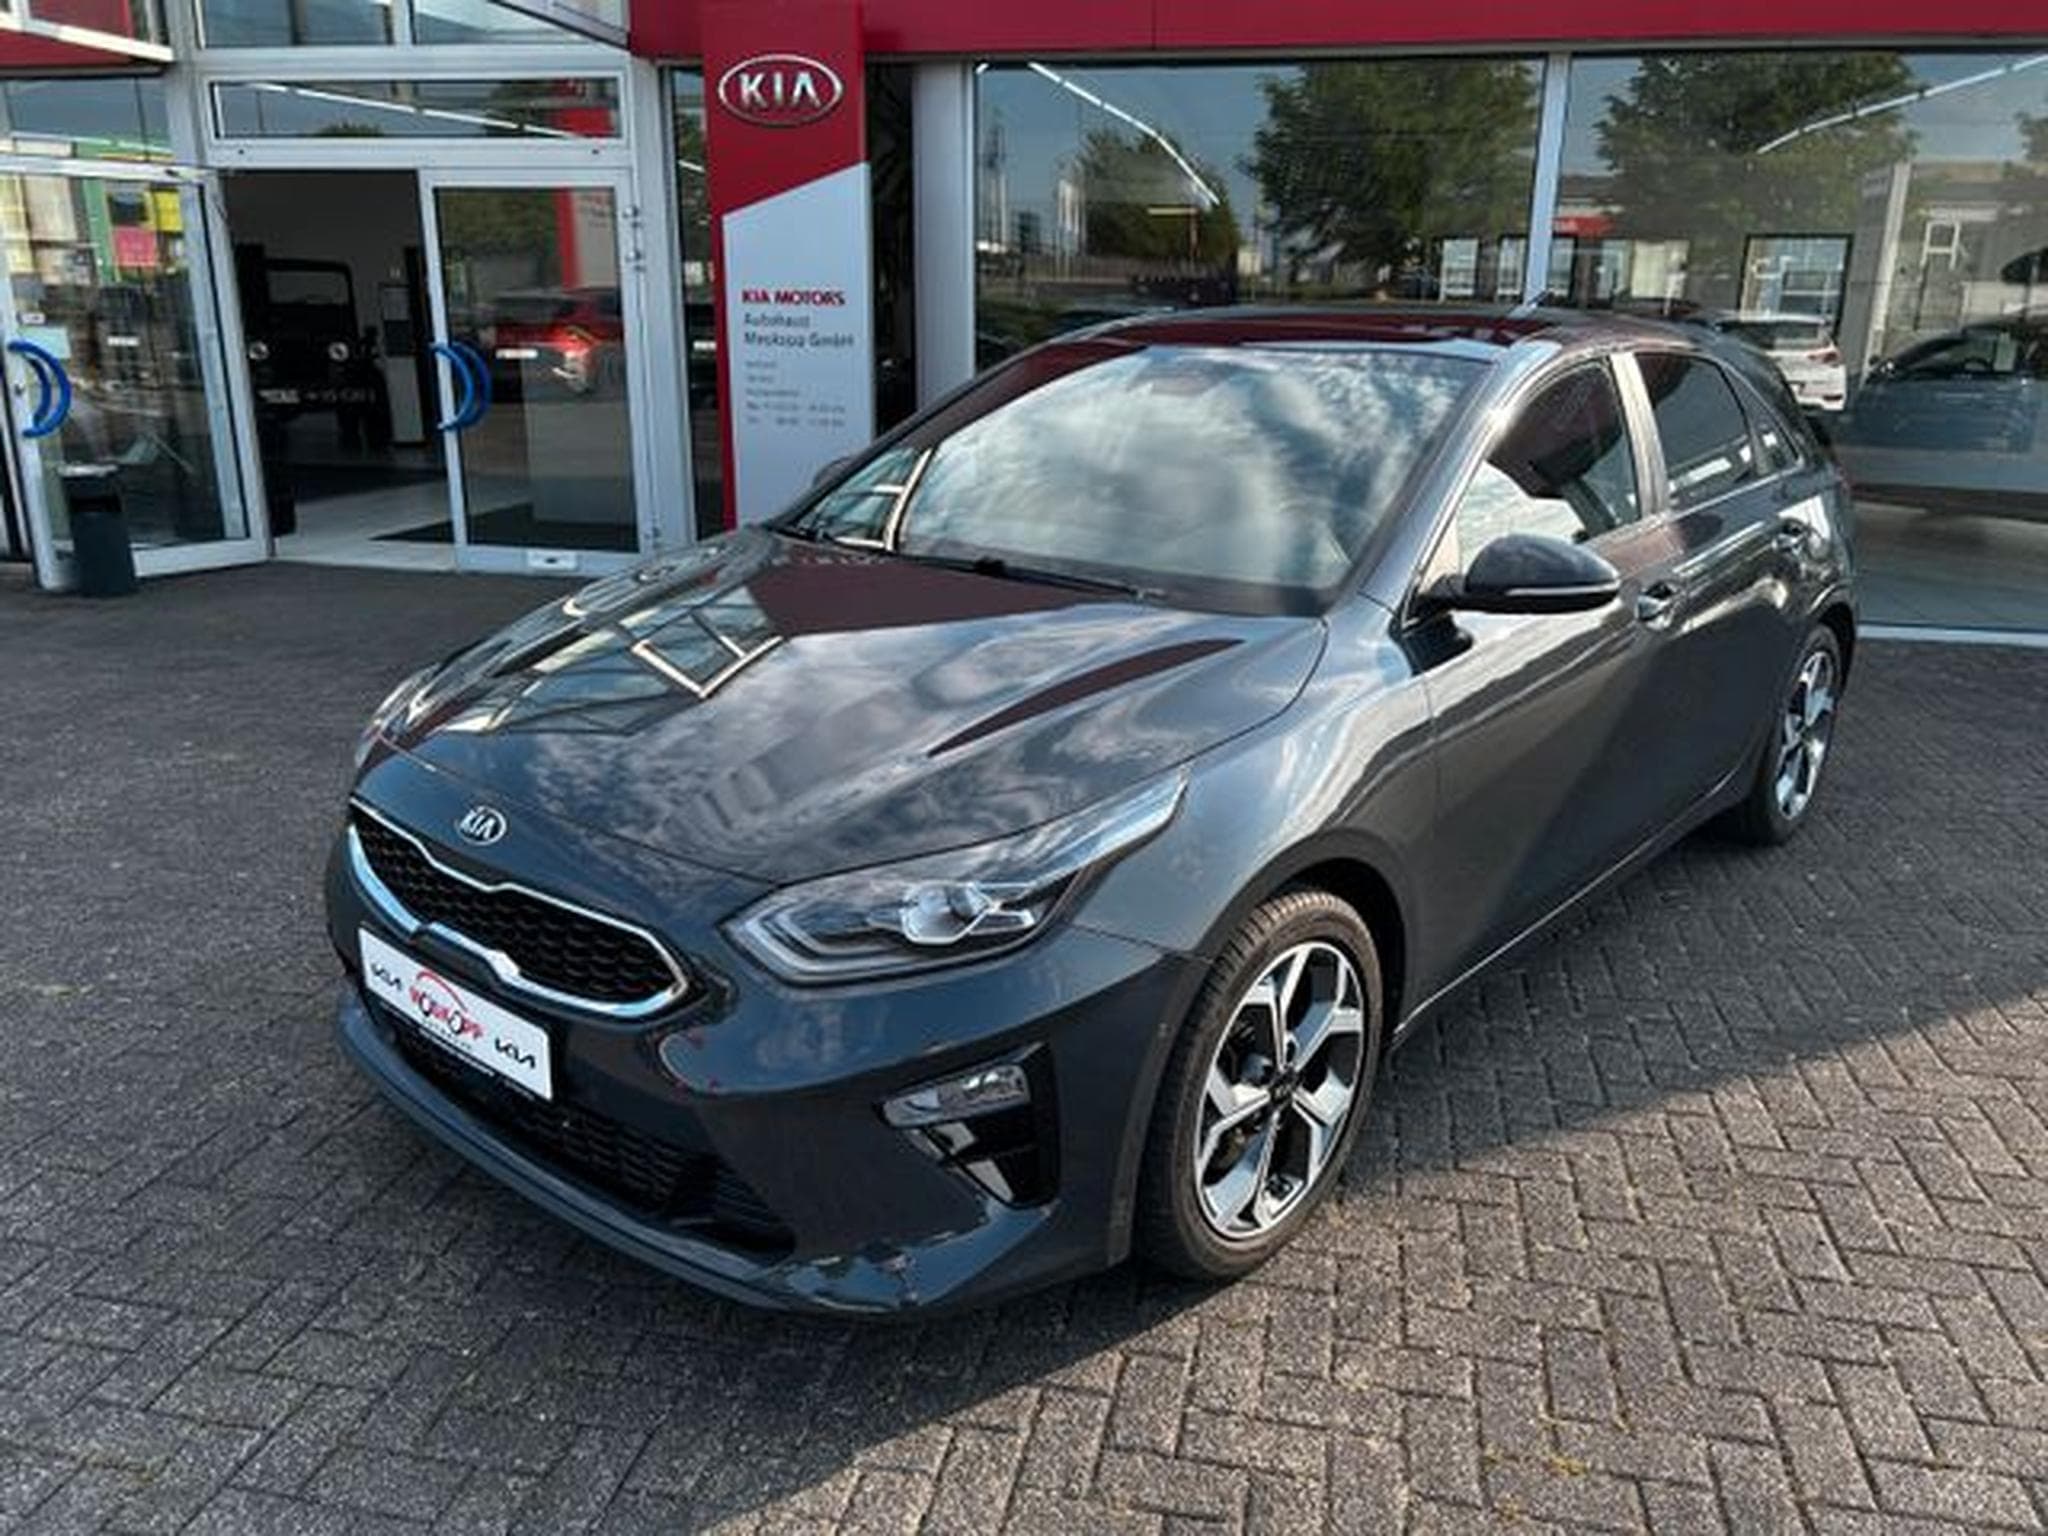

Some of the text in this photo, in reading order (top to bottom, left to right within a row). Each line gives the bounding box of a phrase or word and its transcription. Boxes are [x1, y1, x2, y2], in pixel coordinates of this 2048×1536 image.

[739, 71, 822, 108] KIA
[742, 289, 846, 306] KIA MOTORS
